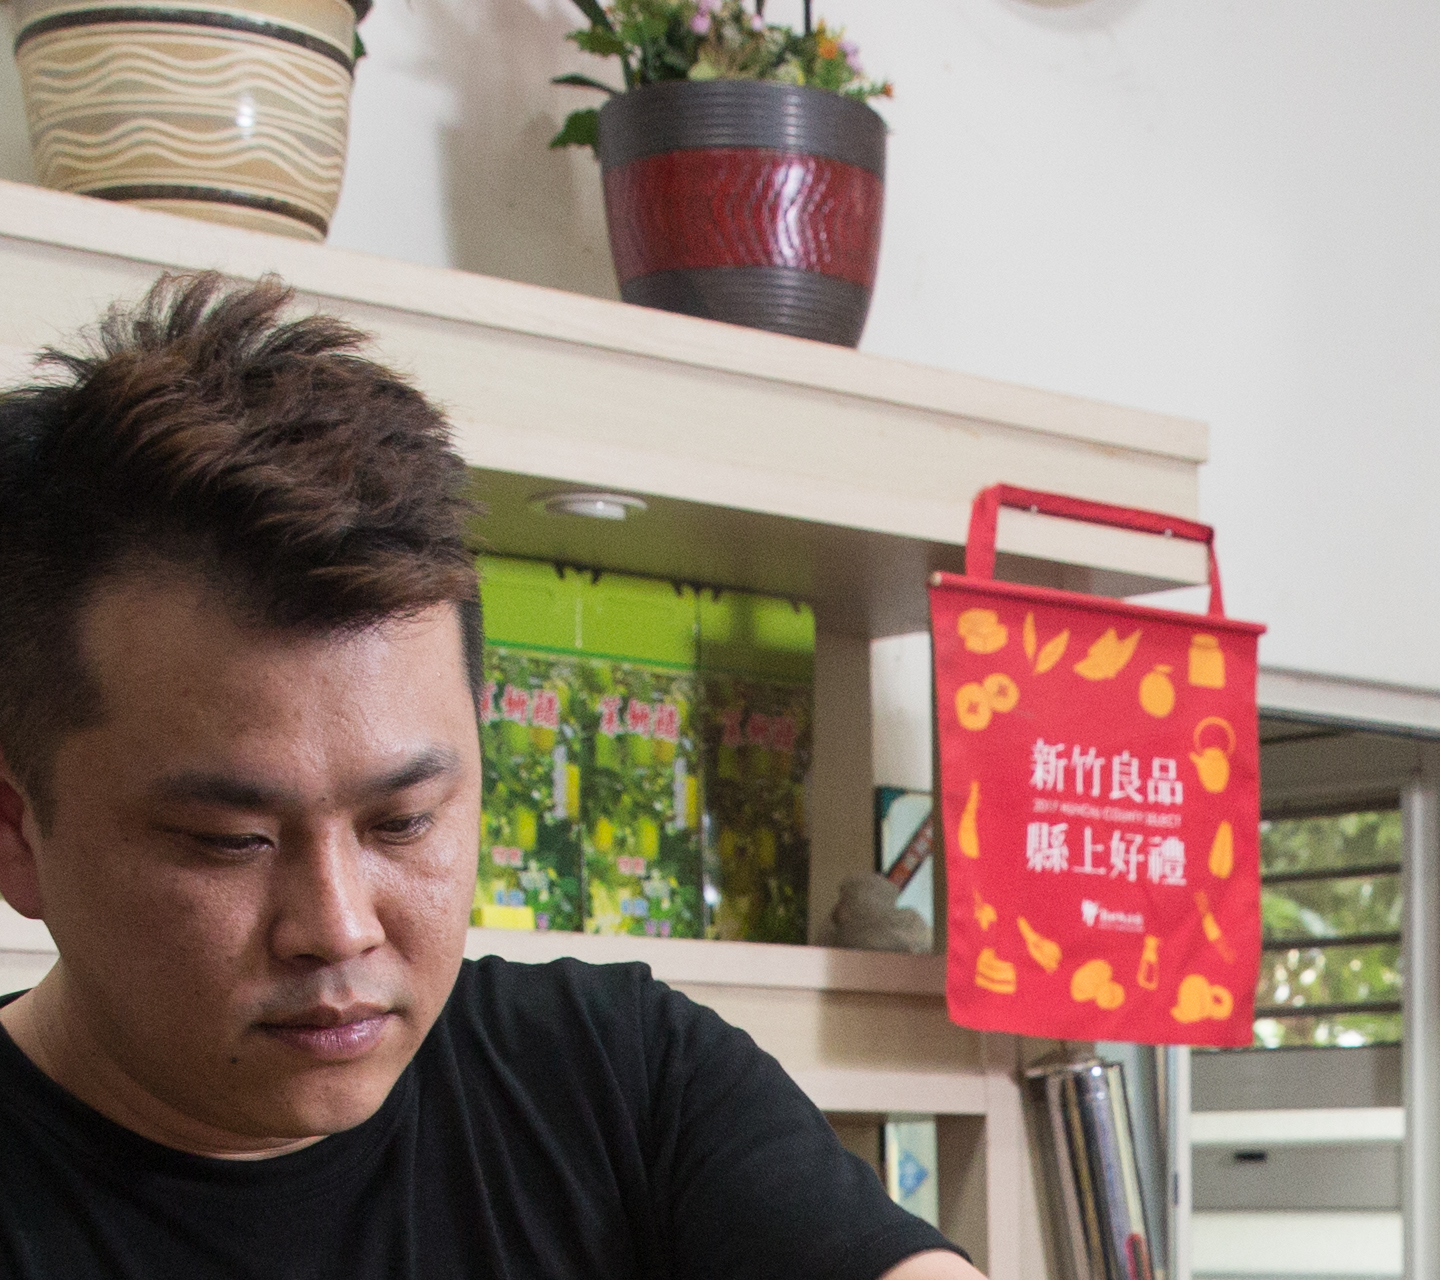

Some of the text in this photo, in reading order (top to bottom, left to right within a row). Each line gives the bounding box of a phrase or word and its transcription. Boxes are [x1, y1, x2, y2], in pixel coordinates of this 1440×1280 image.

[1029, 737, 1184, 806] 新竹良品
[1026, 822, 1188, 887] 縣上好禮
